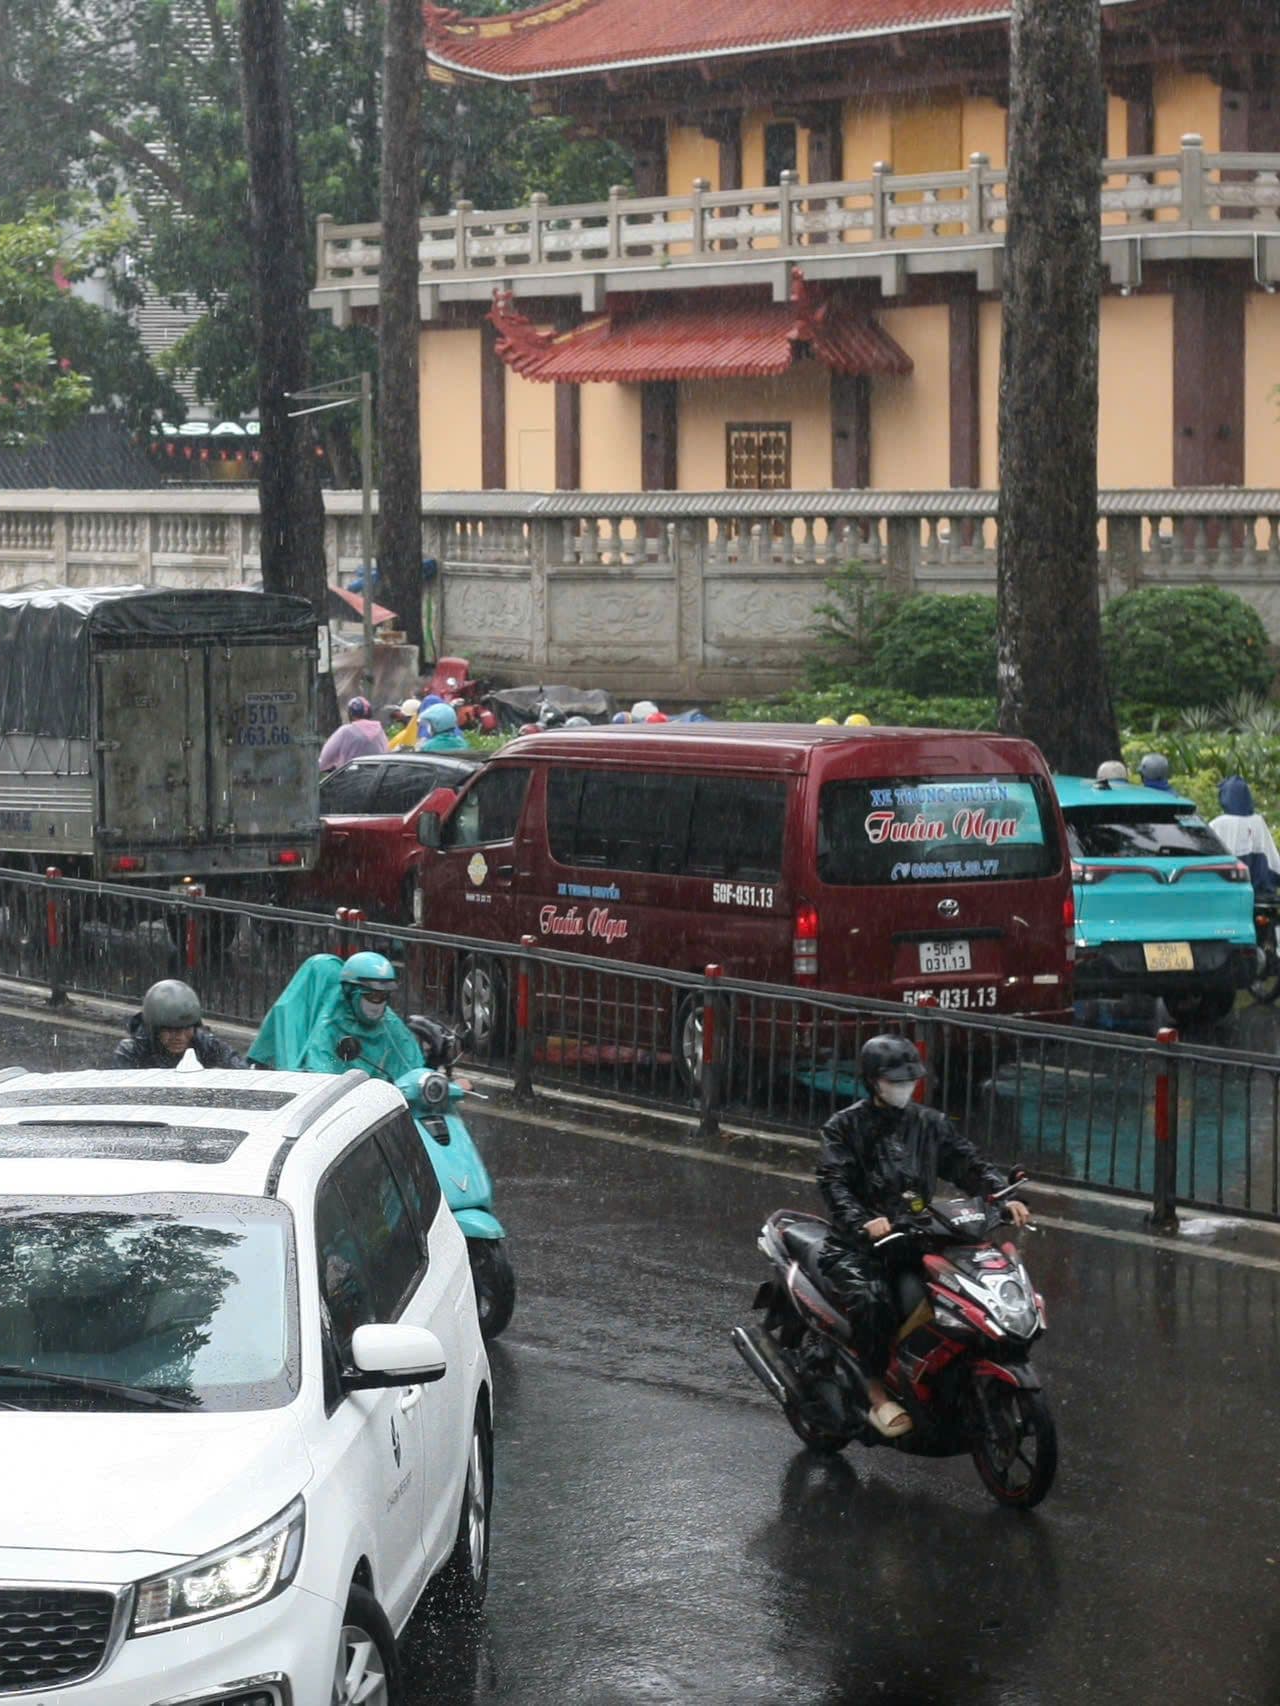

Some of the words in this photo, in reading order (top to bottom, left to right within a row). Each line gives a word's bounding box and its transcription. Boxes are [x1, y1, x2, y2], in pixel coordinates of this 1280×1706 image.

[952, 808, 1019, 845] Nga
[713, 883, 773, 908] 50F-031.13
[588, 907, 628, 944] Nga
[933, 943, 954, 956] 50F
[926, 957, 965, 971] 031.13
